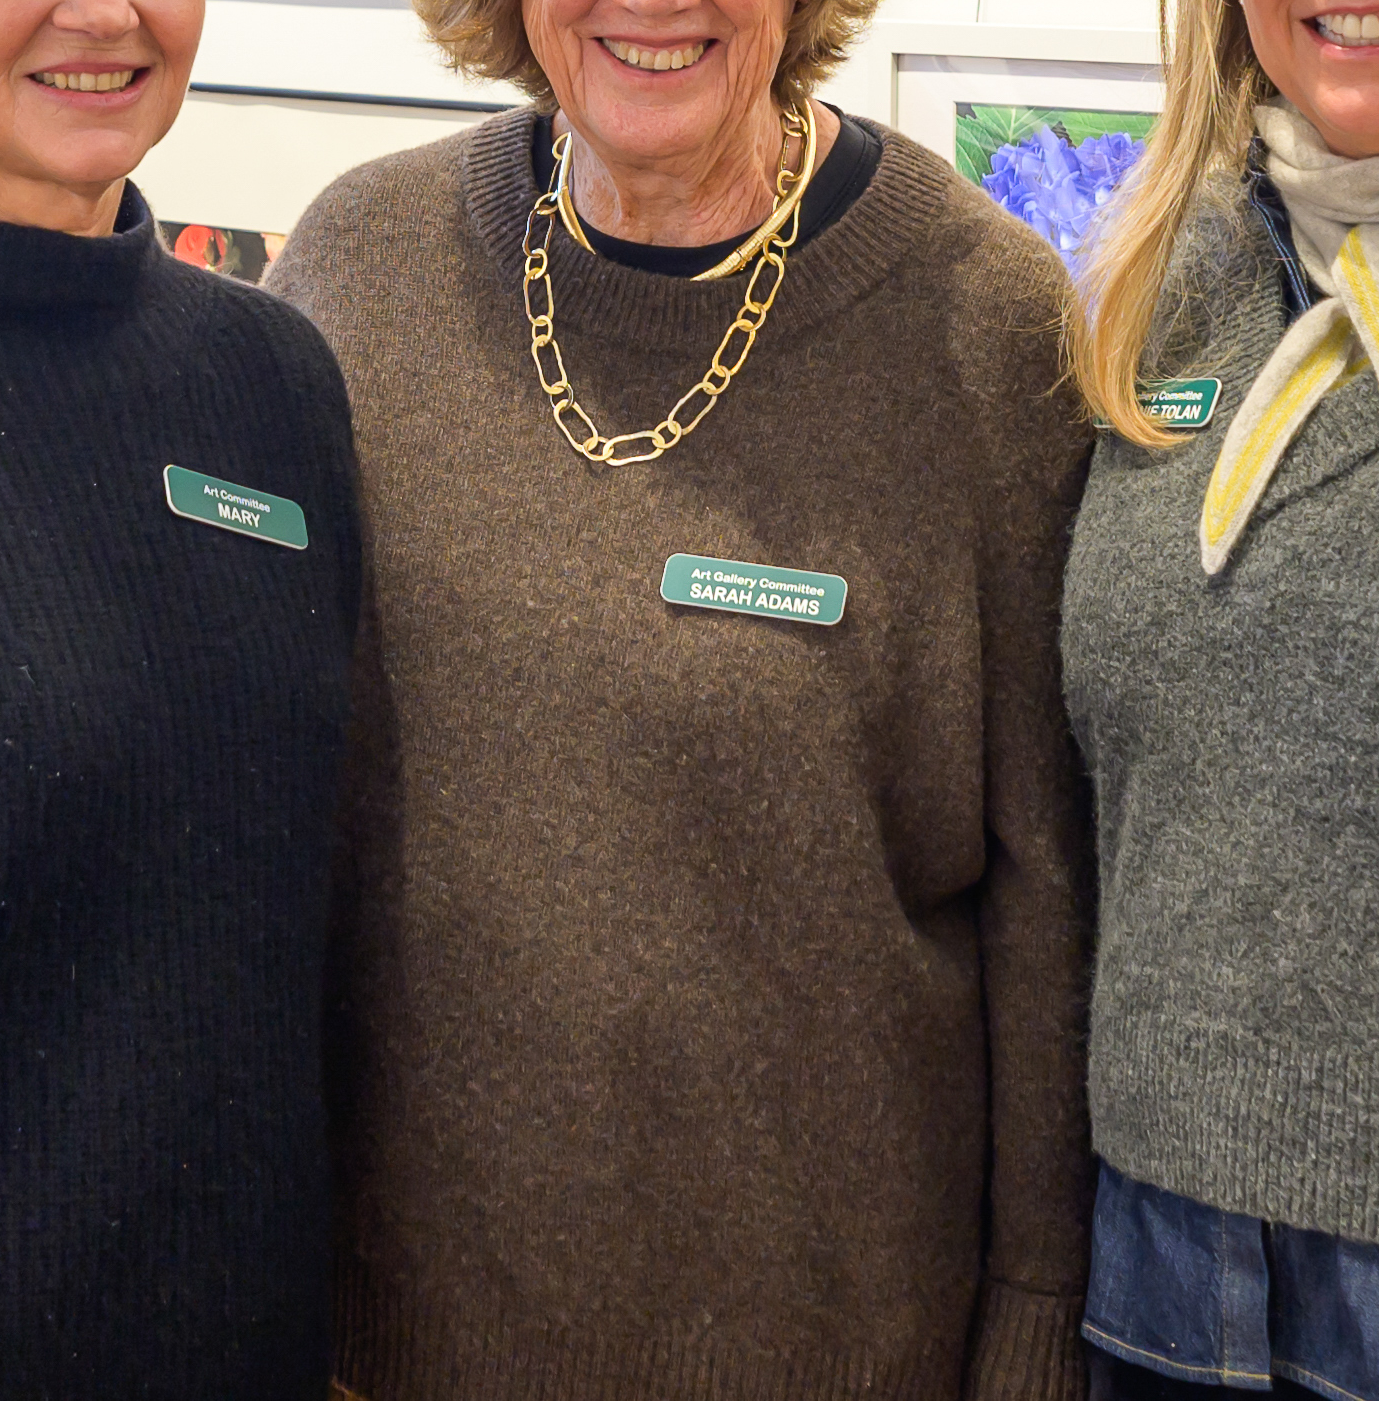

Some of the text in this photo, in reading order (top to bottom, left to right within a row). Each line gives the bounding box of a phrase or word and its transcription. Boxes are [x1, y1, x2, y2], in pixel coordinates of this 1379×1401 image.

[1158, 390, 1203, 401] Committee
[1160, 404, 1202, 420] TOLAN
[203, 484, 271, 513] Art Committee
[217, 503, 261, 529] MARY
[691, 567, 825, 597] Art Gallery Committee
[689, 583, 820, 616] SARAH ADAMS
